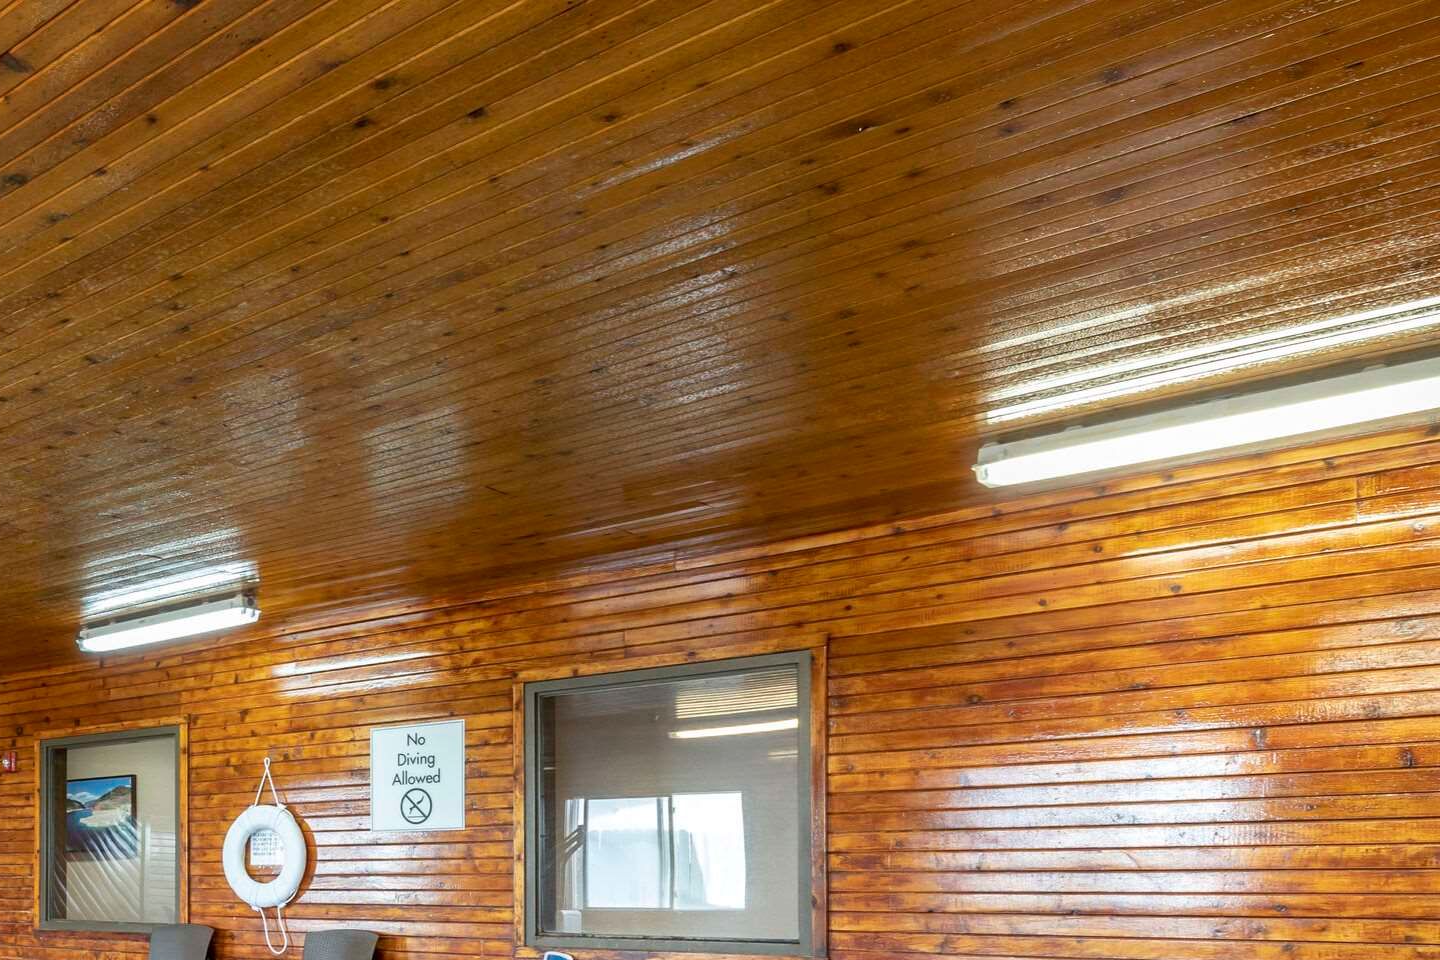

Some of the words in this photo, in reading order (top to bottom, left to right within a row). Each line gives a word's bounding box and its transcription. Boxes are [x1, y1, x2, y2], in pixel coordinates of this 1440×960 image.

[407, 733, 426, 746] No
[397, 752, 436, 768] Diving
[392, 768, 441, 786] Allowed
